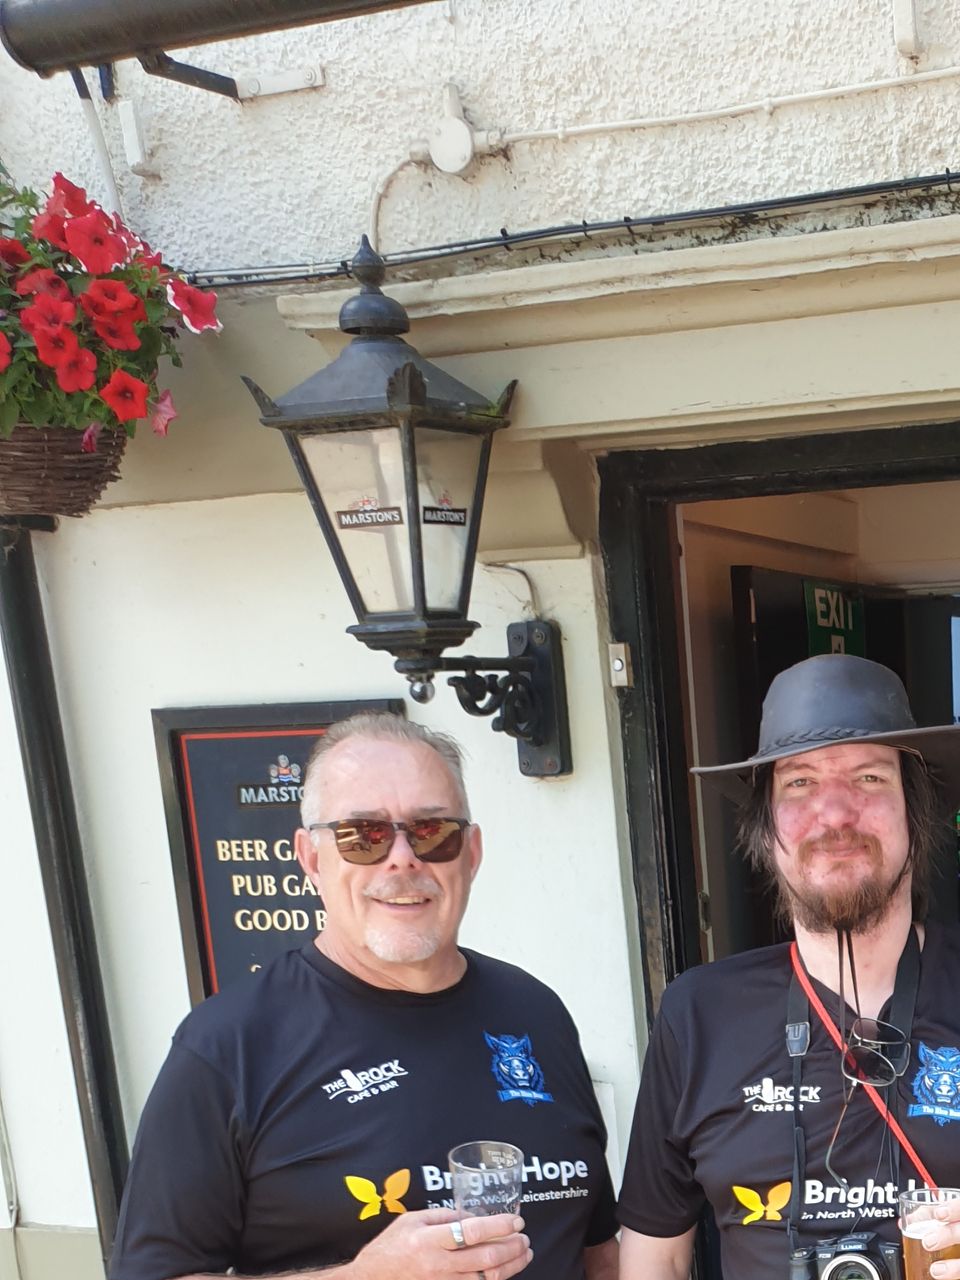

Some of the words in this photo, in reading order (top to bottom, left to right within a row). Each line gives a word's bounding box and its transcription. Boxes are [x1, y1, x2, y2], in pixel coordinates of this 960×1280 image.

[341, 510, 400, 525] MARSTON'S
[216, 839, 270, 861] BEER
[232, 874, 277, 896] PUB
[282, 874, 321, 896] GA
[234, 908, 310, 931] GOOD
[321, 1079, 347, 1094] THE
[356, 1060, 405, 1085] ROCK
[379, 1080, 399, 1092] BAR
[742, 1085, 761, 1097] THE
[421, 1162, 511, 1195] Brght
[513, 1156, 589, 1187] Hope
[804, 1179, 899, 1208] Bright
[816, 1209, 855, 1219] North
[858, 1206, 895, 1218] West
